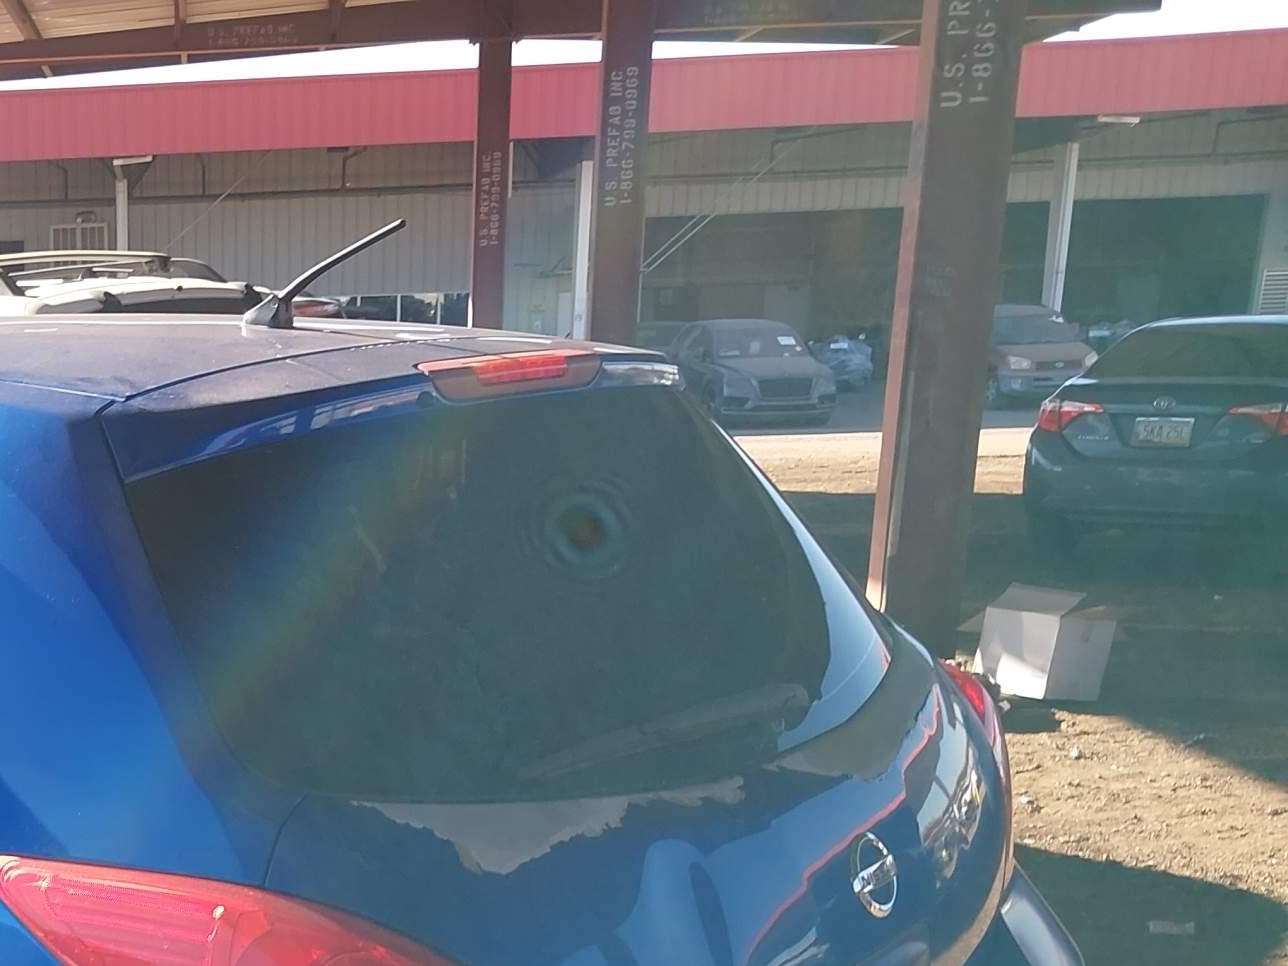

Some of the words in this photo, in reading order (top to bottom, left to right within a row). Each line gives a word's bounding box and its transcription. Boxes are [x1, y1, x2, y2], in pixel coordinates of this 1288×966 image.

[939, 52, 967, 108] U.S.
[968, 0, 1000, 104] 1-866-
[606, 104, 622, 167] PREFAB
[619, 66, 640, 204] 1-866-799-0969
